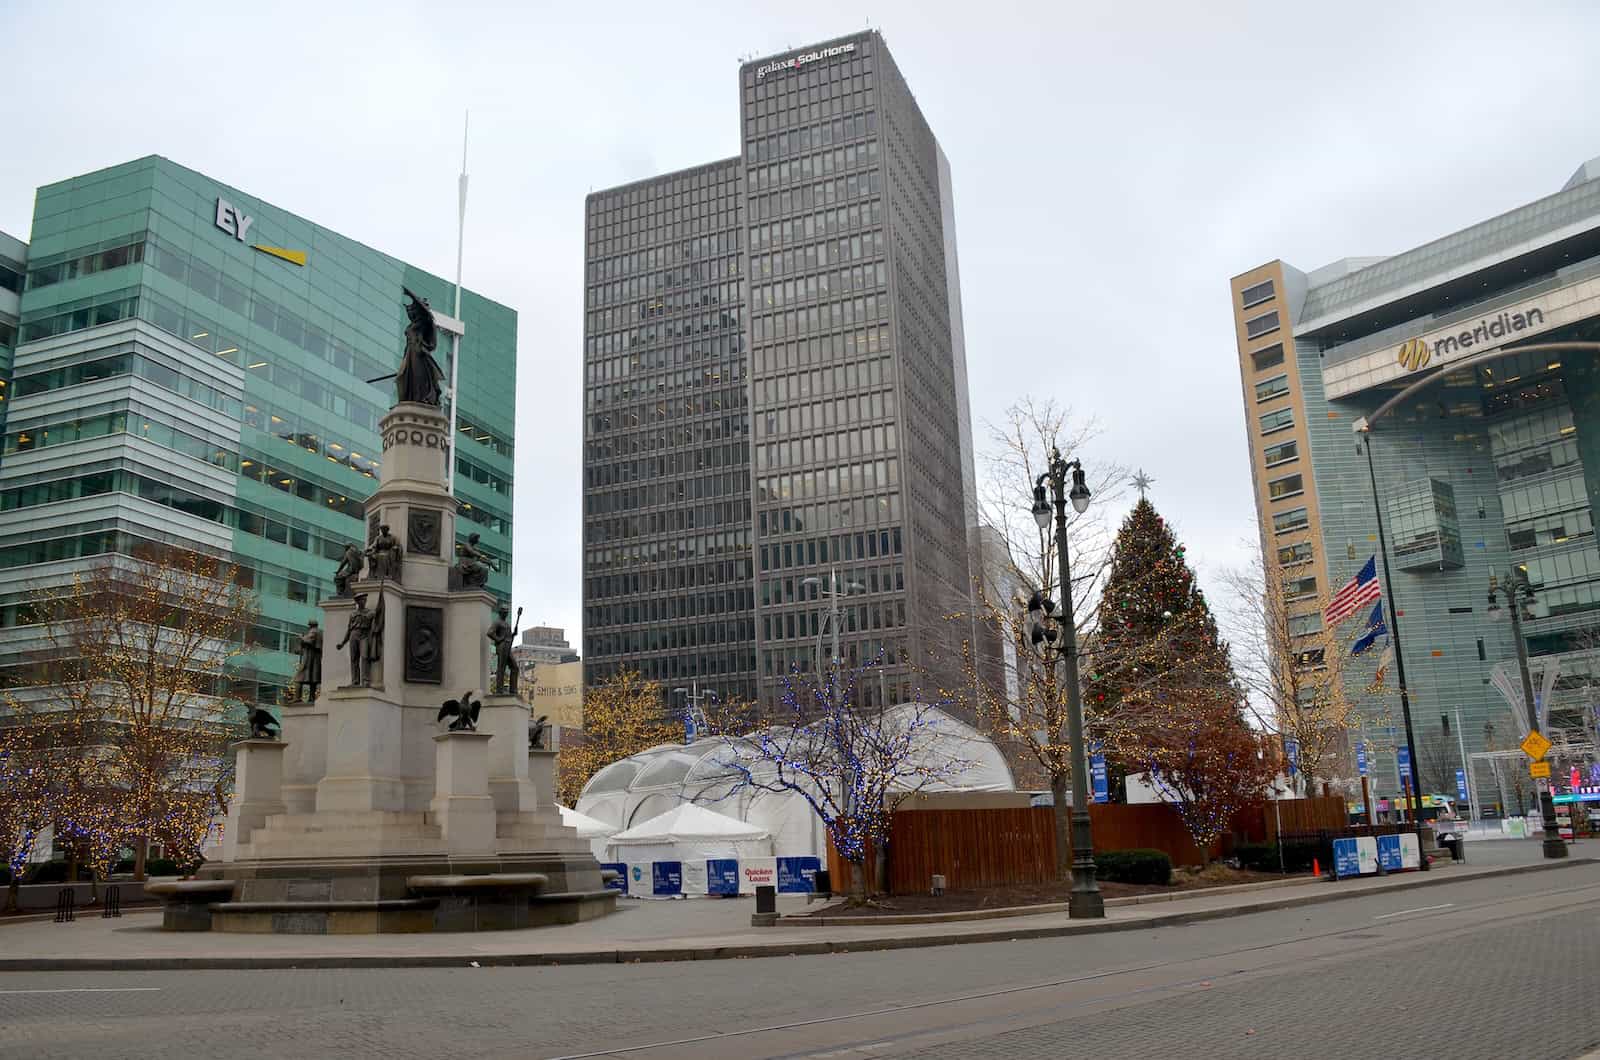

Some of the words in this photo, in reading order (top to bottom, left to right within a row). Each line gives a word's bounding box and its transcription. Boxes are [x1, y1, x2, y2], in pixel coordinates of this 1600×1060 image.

[215, 196, 254, 241] EY
[1433, 307, 1545, 357] meridian
[744, 867, 774, 877] Quicken
[749, 875, 771, 883] Loans
